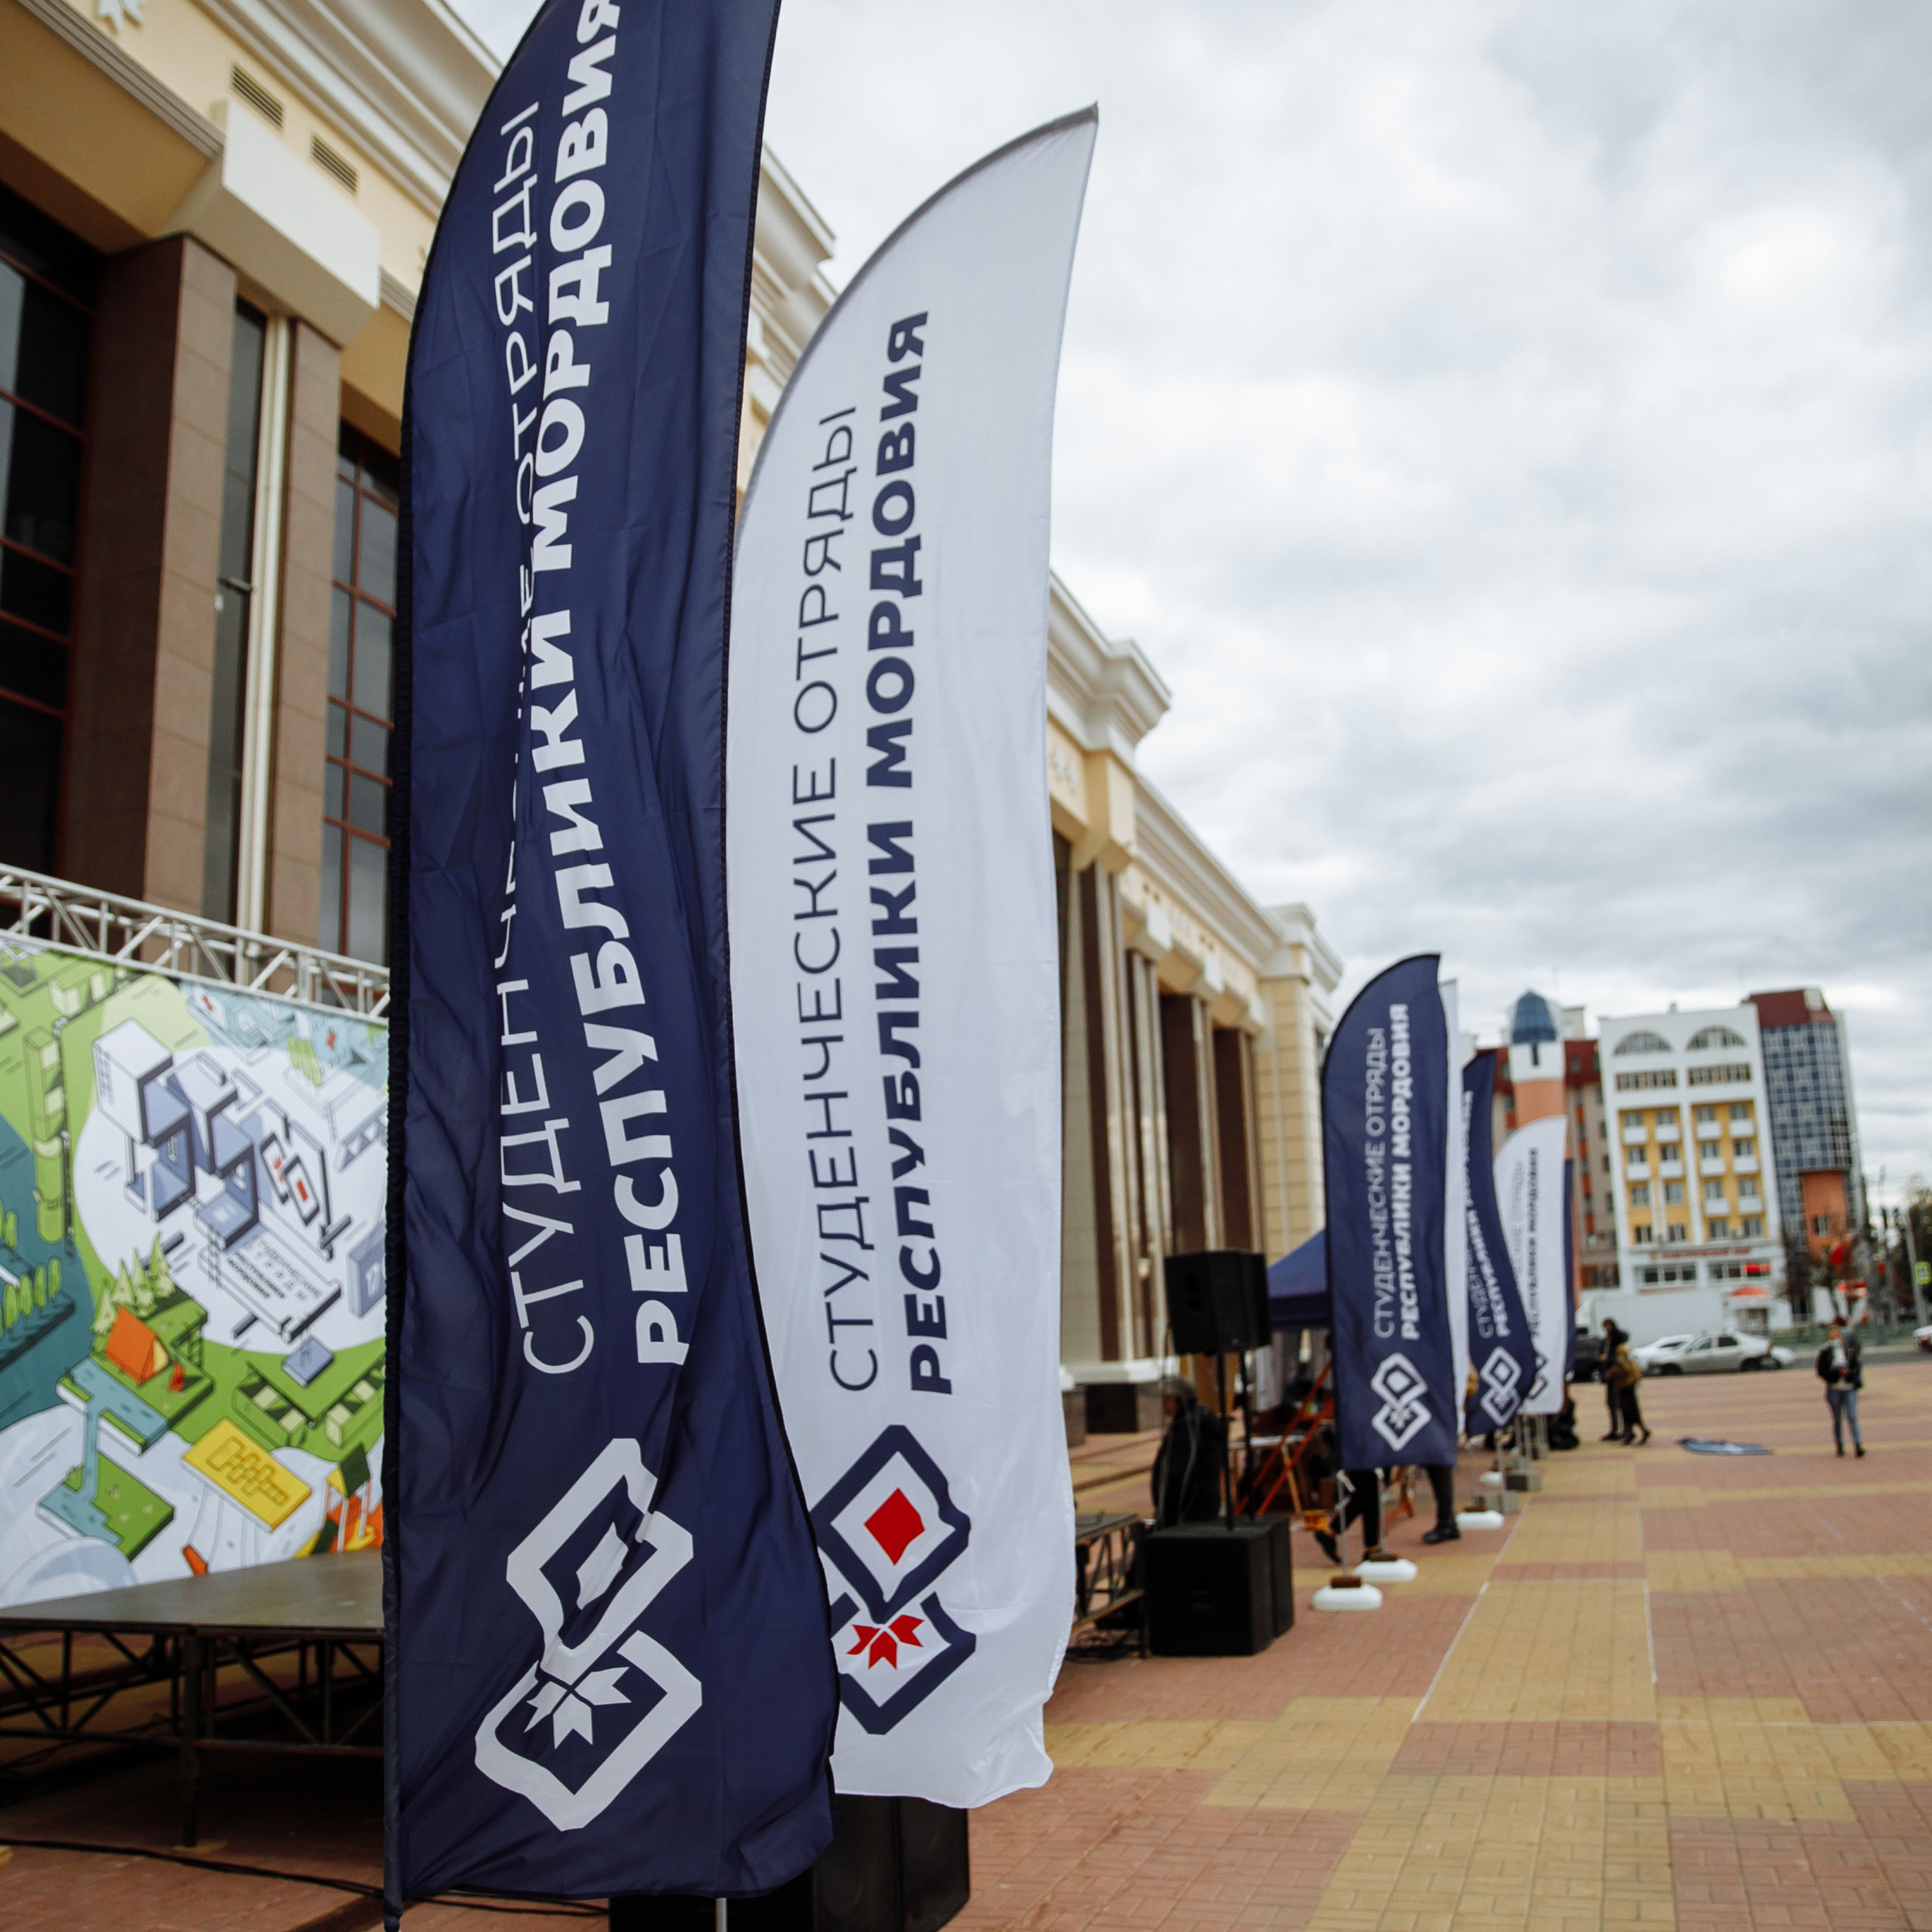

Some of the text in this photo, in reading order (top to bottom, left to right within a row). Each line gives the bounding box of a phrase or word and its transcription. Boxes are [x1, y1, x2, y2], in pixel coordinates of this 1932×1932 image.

[493, 101, 539, 525] ОТРЯДЫ
[531, 0, 690, 1365] РЕСПУБЛИКИ МОРДОВИЯ
[792, 406, 878, 1391] СТУДЕНЧЕСКИЕ ОТРЯДЫ
[866, 311, 953, 1395] РЕСПУБЛИКИ МОРДОВИЯ
[1365, 1028, 1395, 1339] СТУДЕНЧЕСКИЕ ОТРЯДЫ
[1389, 1003, 1420, 1341] РЕСПУБЛИКИ МОРДОВИЯ
